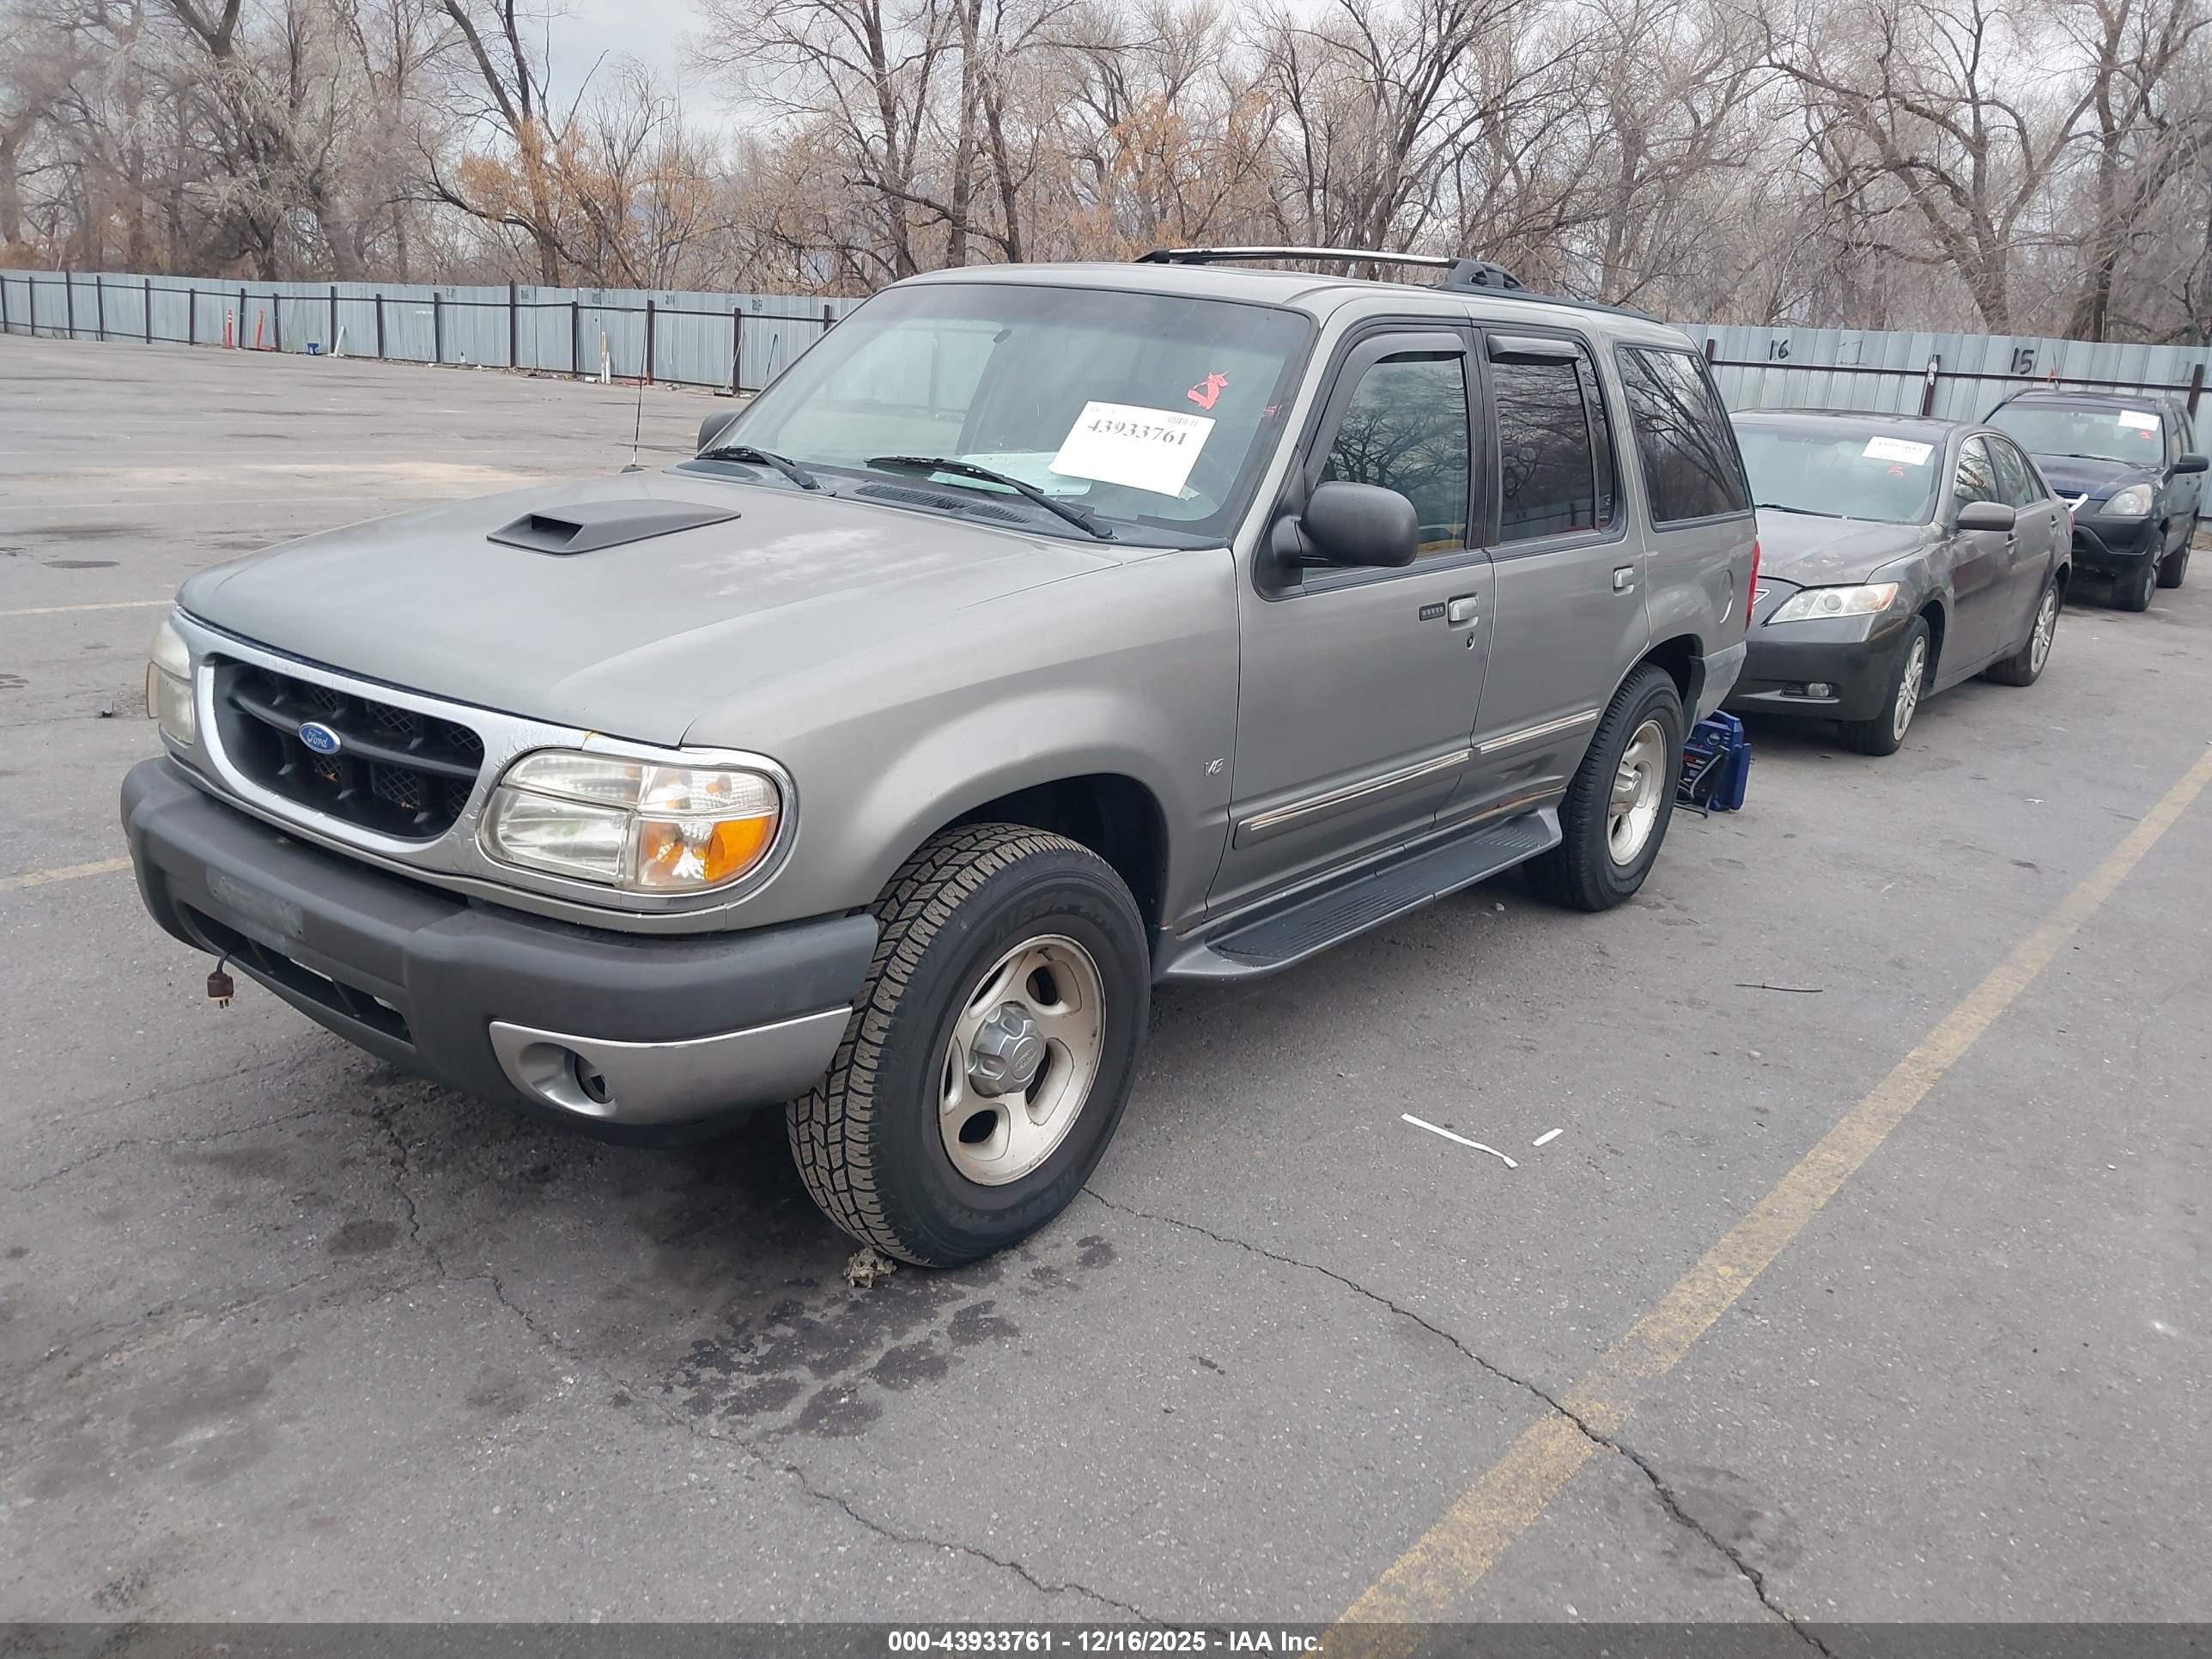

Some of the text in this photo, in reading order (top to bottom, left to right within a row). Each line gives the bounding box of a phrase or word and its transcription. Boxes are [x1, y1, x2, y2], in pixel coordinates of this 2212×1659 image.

[1769, 339, 1789, 362] 16
[2010, 347, 2035, 375] 15
[1087, 419, 1188, 445] 43933761
[307, 727, 329, 749] Ford
